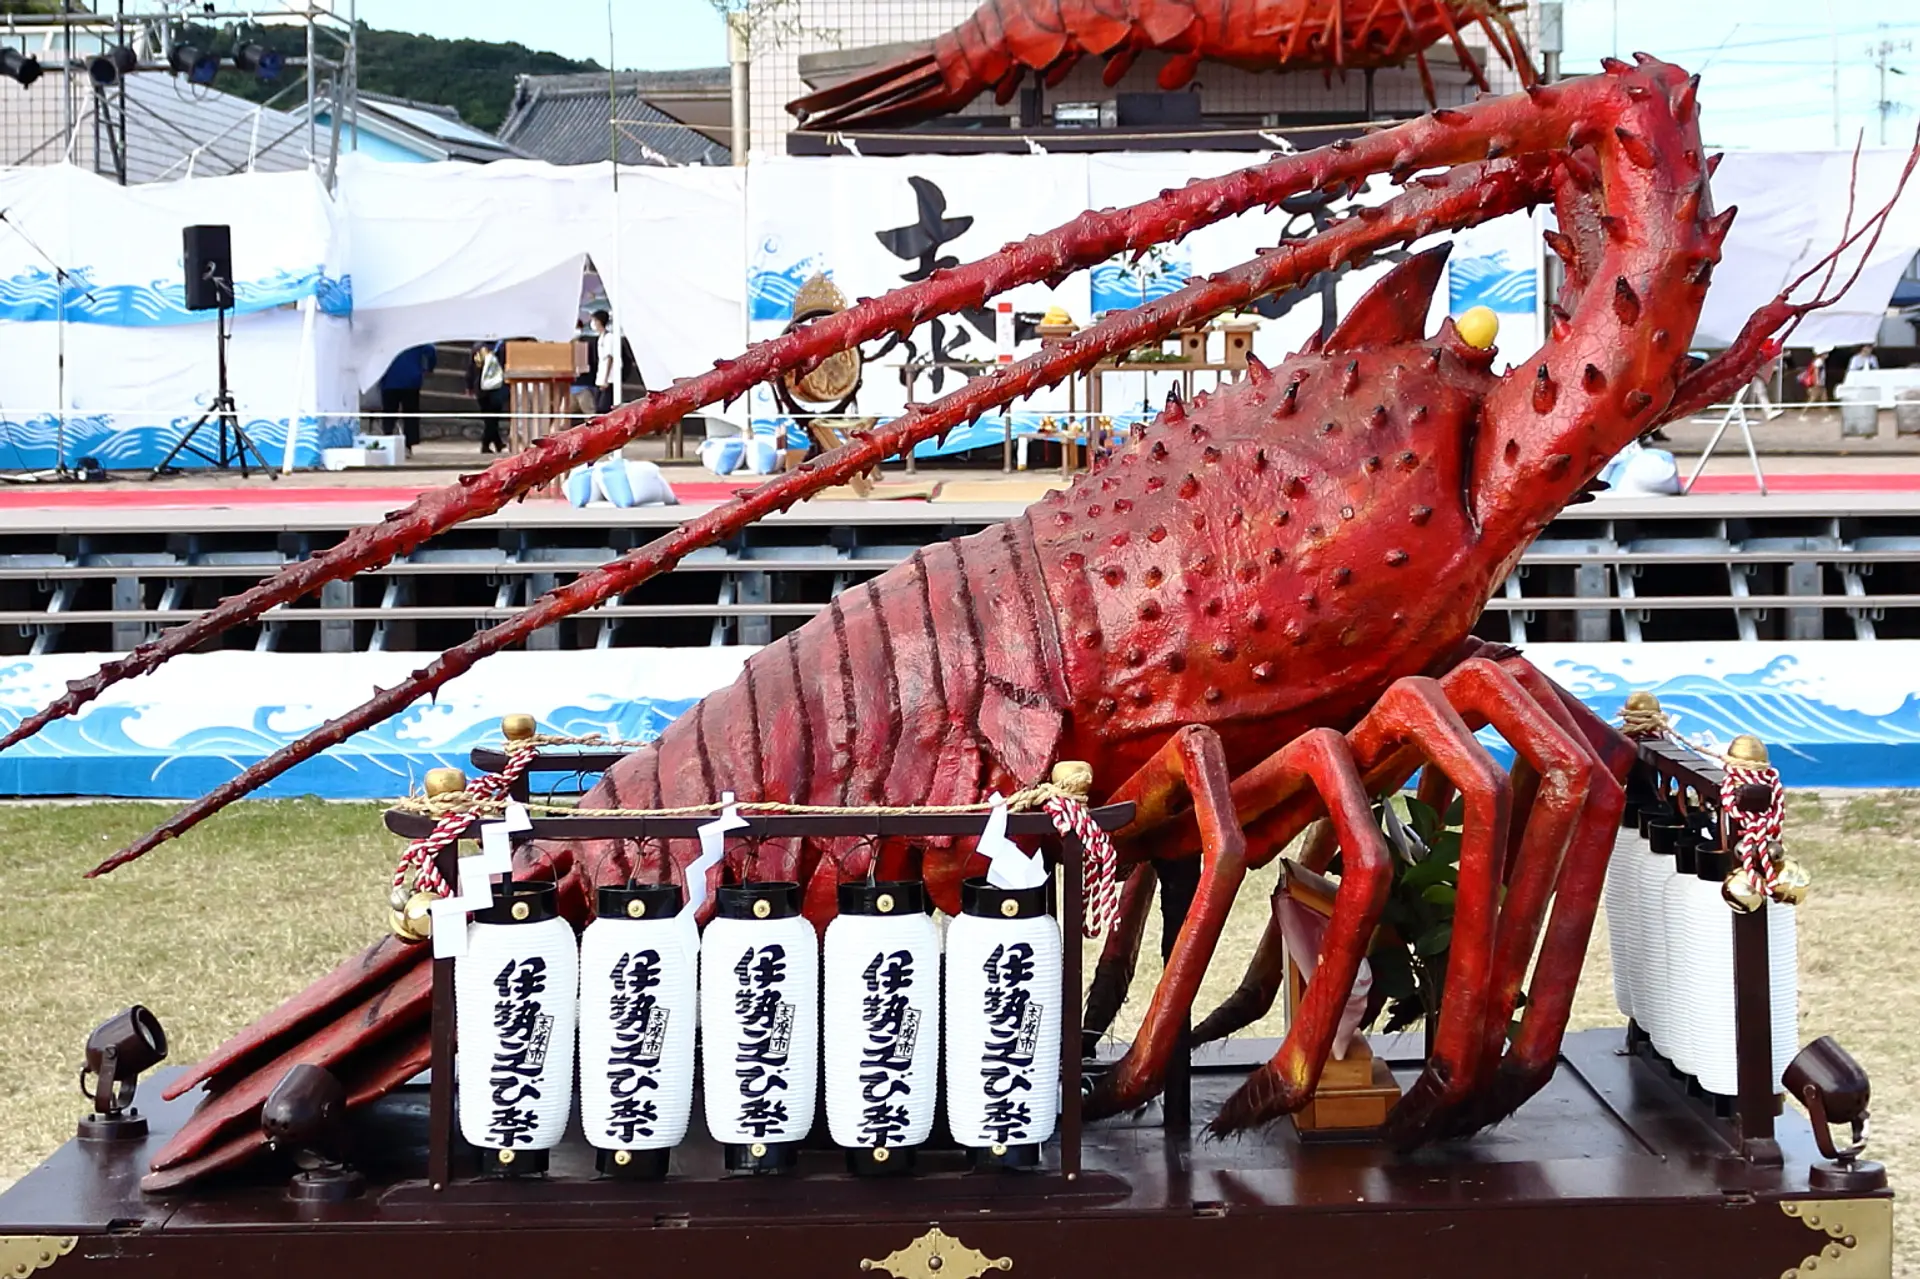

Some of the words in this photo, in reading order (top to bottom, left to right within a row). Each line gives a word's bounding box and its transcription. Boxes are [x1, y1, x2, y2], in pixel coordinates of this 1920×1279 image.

[485, 956, 547, 1147] 伊勢えび祭
[526, 1018, 552, 1064] 志摩市
[605, 949, 662, 1143] 伊勢えび祭
[643, 1010, 668, 1055] 志摩市
[734, 943, 791, 1138] 伊勢えび祭
[771, 1005, 793, 1051] 志摩市
[856, 950, 915, 1148] 伊勢えび祭
[897, 1012, 920, 1056] 志摩市
[978, 942, 1036, 1145] 伊勢えび祭
[1019, 1007, 1042, 1053] 志摩市
